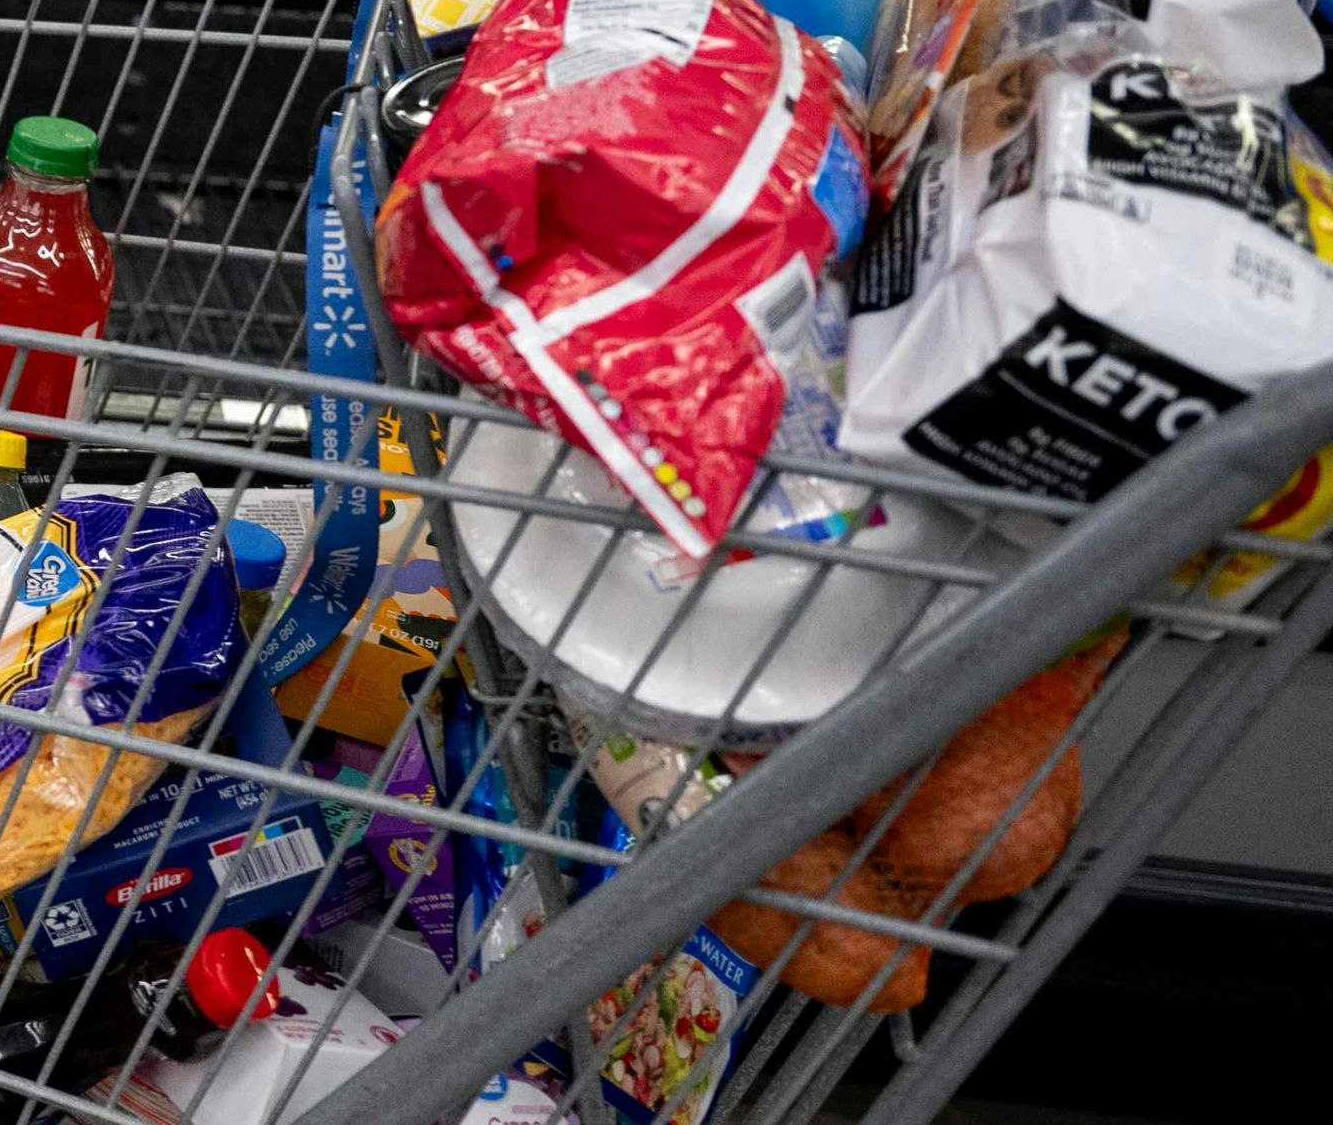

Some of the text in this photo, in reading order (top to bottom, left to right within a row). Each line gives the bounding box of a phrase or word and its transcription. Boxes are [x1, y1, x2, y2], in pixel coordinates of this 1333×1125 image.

[26, 569, 44, 600] Valu
[42, 555, 66, 596] Grea
[412, 635, 440, 650] (19
[218, 783, 238, 800] NET
[133, 818, 170, 836] ENRICH
[117, 873, 186, 903] Brilla
[700, 935, 745, 986] WATER
